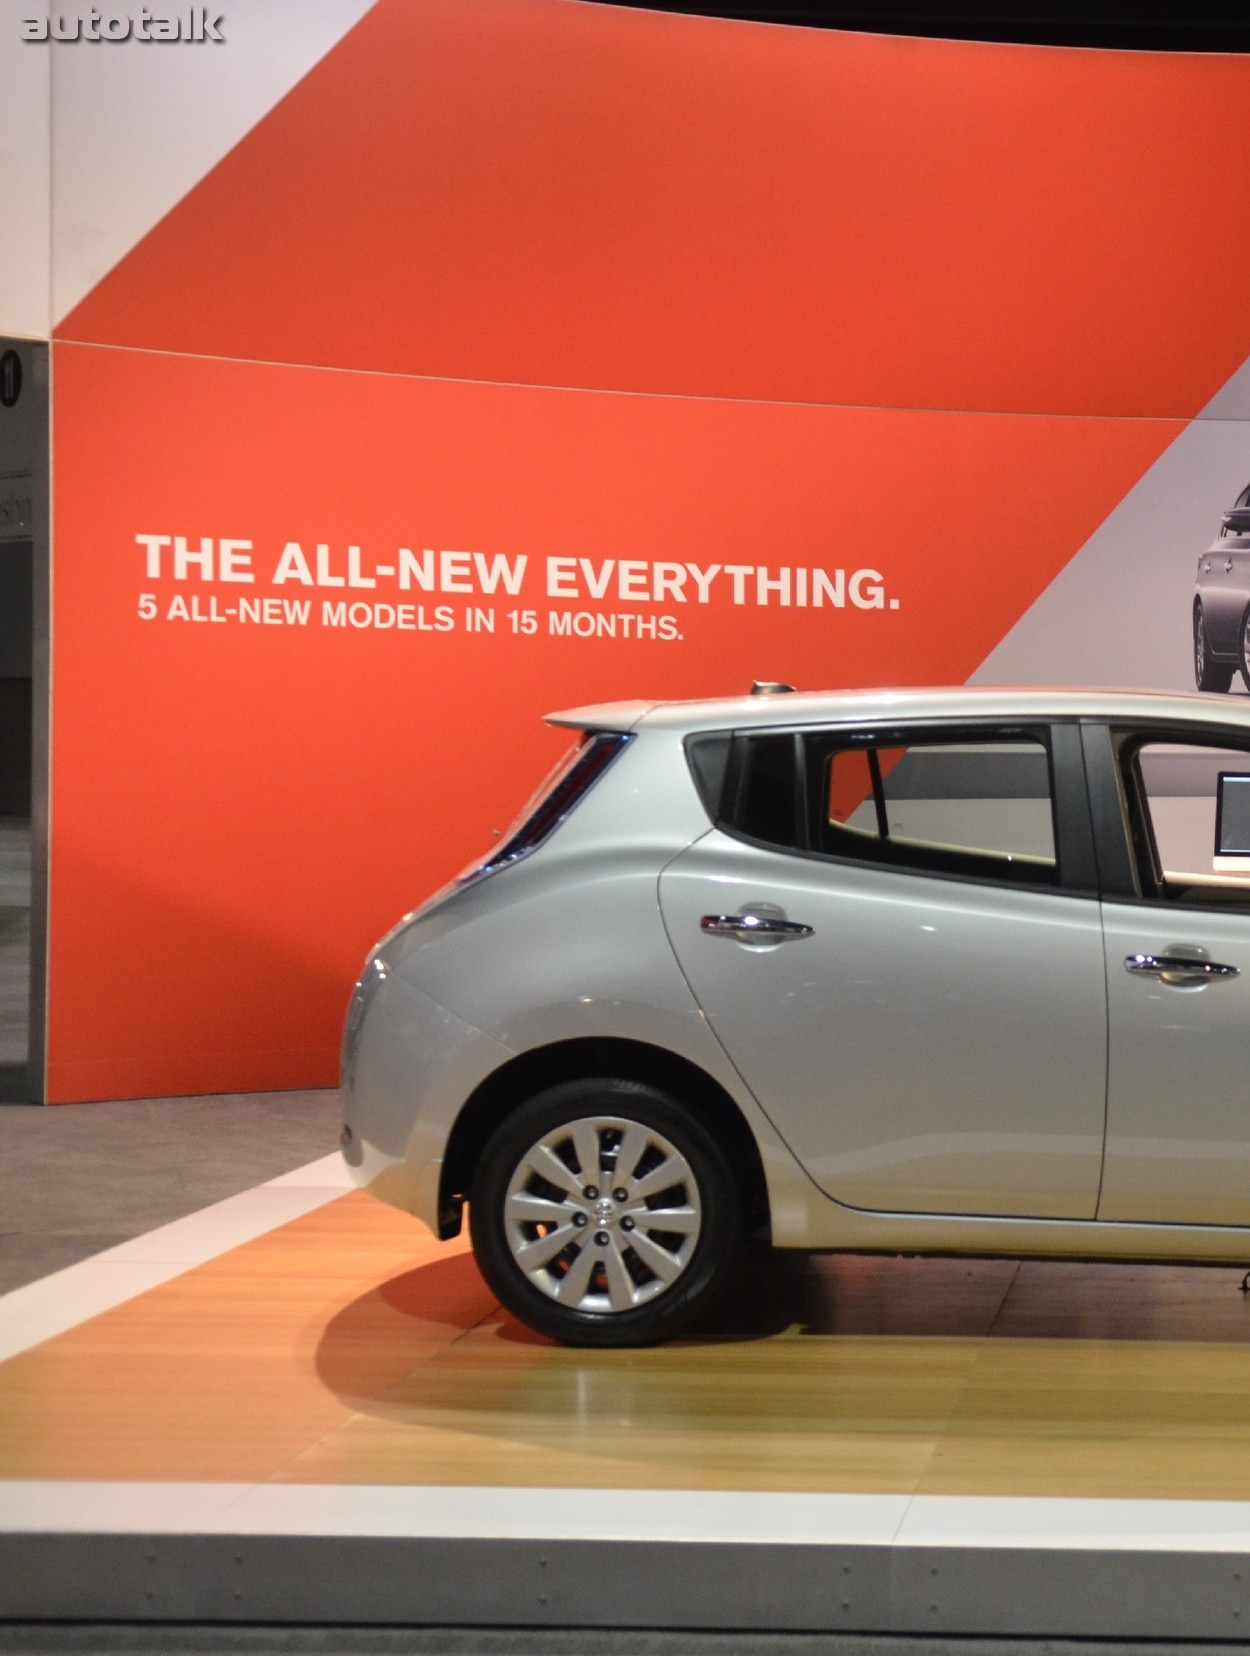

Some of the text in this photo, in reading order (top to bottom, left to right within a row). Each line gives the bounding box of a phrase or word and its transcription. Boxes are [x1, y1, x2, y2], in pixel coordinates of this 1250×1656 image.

[135, 534, 900, 609] THE ALL-NEW EVERYTHING.
[138, 593, 684, 640] 5 ALL-NEW MODELS IN 15 MONTHS.
